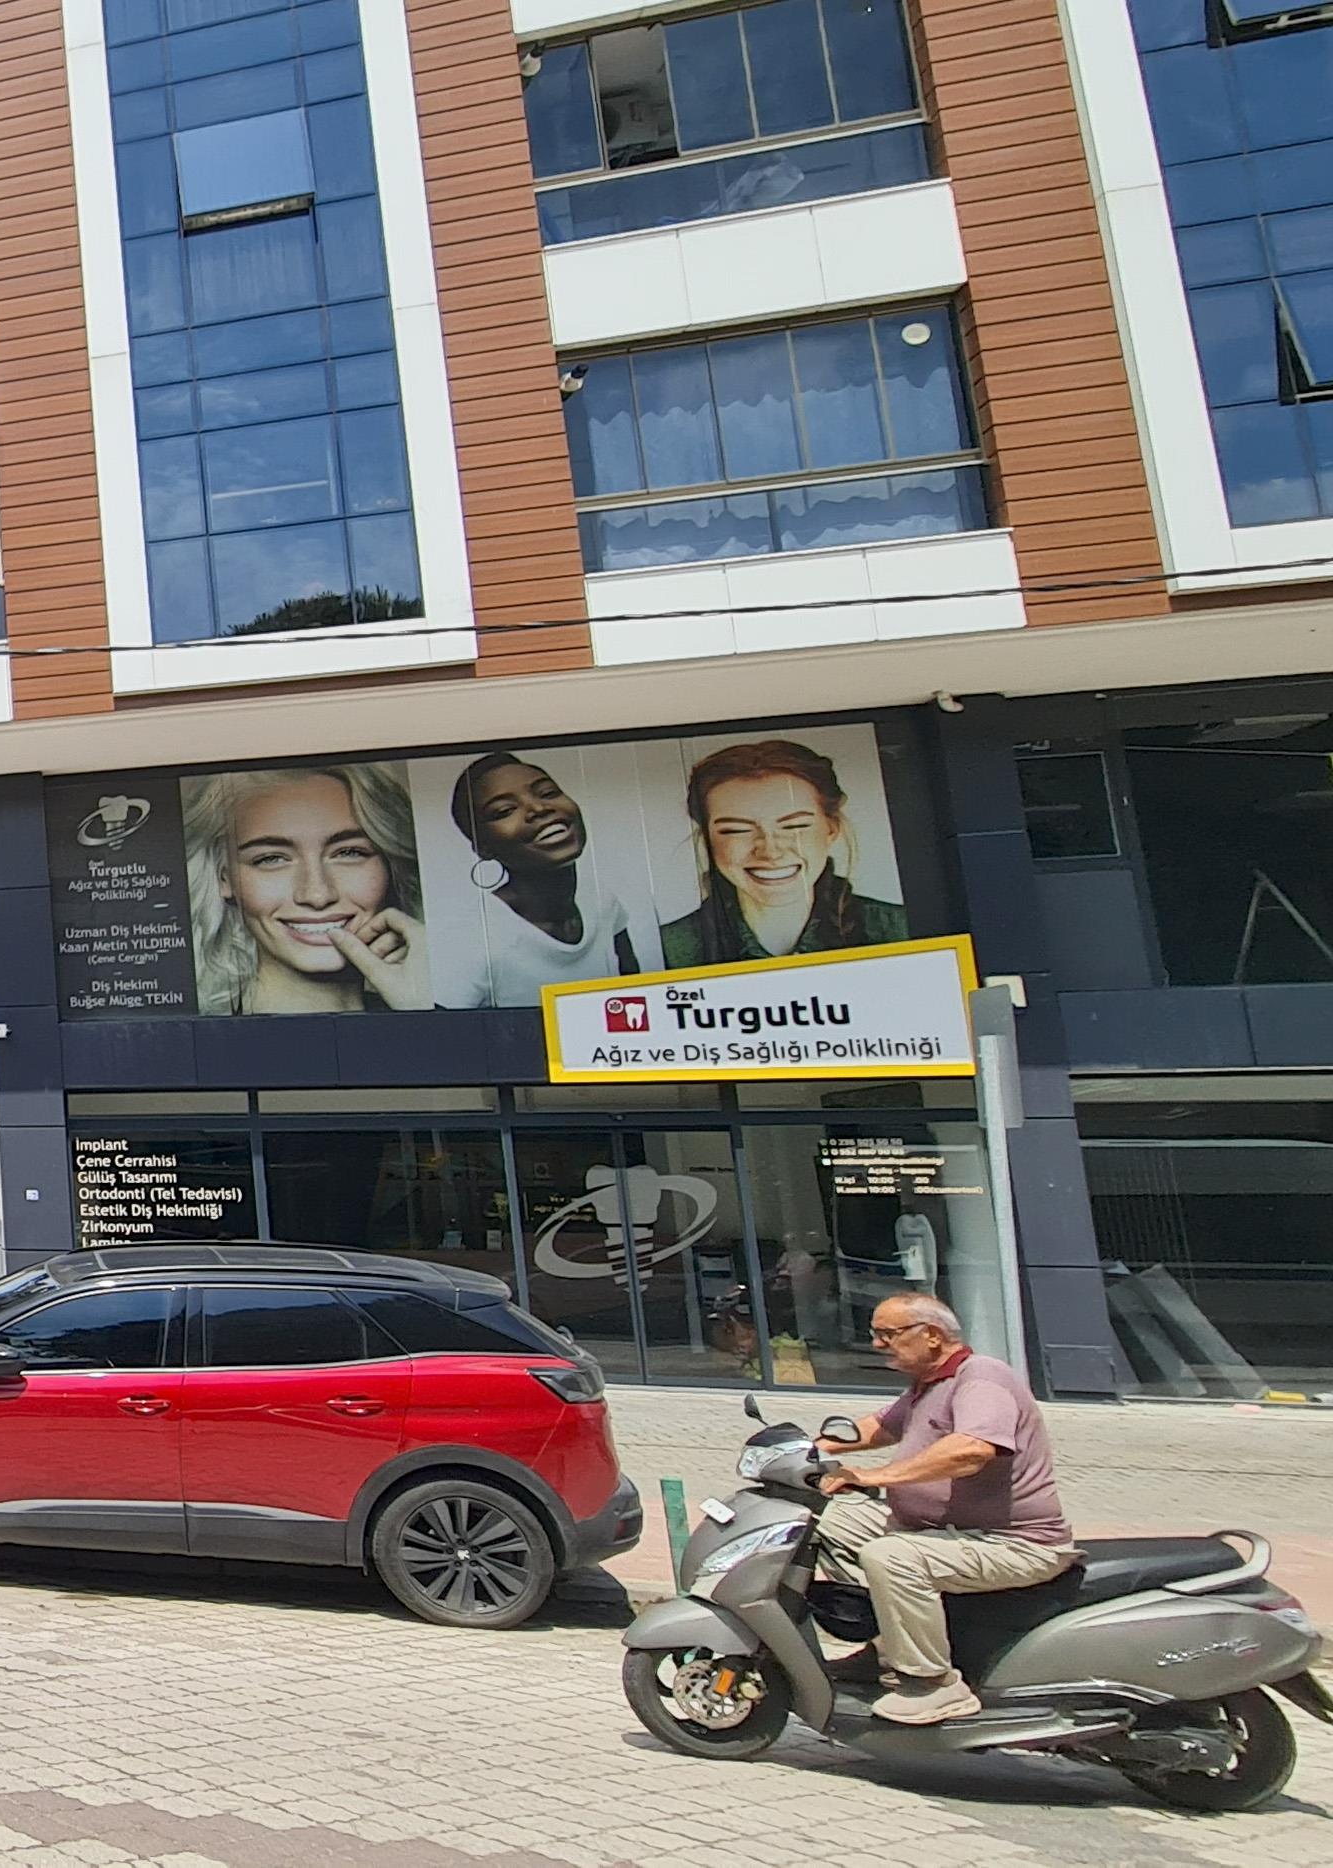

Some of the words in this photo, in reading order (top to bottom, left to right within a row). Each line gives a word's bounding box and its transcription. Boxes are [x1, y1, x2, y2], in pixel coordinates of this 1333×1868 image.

[89, 863, 146, 878] Turgutlu
[68, 880, 92, 892] Ağız
[95, 881, 108, 889] ve
[111, 878, 129, 890] Diş
[132, 875, 170, 889] Sağlığı
[91, 889, 146, 901] Polikliniği
[65, 928, 106, 938] Uzman
[111, 925, 129, 938] Diş
[59, 943, 89, 953] Kaan
[93, 941, 128, 952] Metin
[131, 937, 186, 950] YILDIRIM
[92, 980, 110, 994] Diş
[114, 979, 158, 991] Hekimi
[666, 986, 704, 1001] Özel
[109, 994, 144, 1008] Müge
[145, 991, 183, 1005] TEKİN
[667, 996, 851, 1034] Turgutlu
[592, 1045, 642, 1067] Ağız
[649, 1047, 675, 1062] ve
[684, 1043, 721, 1065] Diş
[728, 1040, 808, 1064] Sağlığı
[817, 1037, 941, 1060] Polikliniği
[75, 1137, 128, 1153] İmplant
[76, 1155, 111, 1169] Çene
[115, 1154, 177, 1167] Cerrahisi
[77, 1171, 116, 1186] Gülüş
[118, 1171, 177, 1183] Tasarımı
[78, 1187, 145, 1200] Ortodonti
[150, 1187, 176, 1202] (Tel
[179, 1187, 243, 1202] Tedavisi)
[80, 1204, 128, 1217] Estetik
[131, 1204, 152, 1219] Diş
[156, 1203, 223, 1219] Hekimliği
[81, 1220, 153, 1235] Zirkonyum
